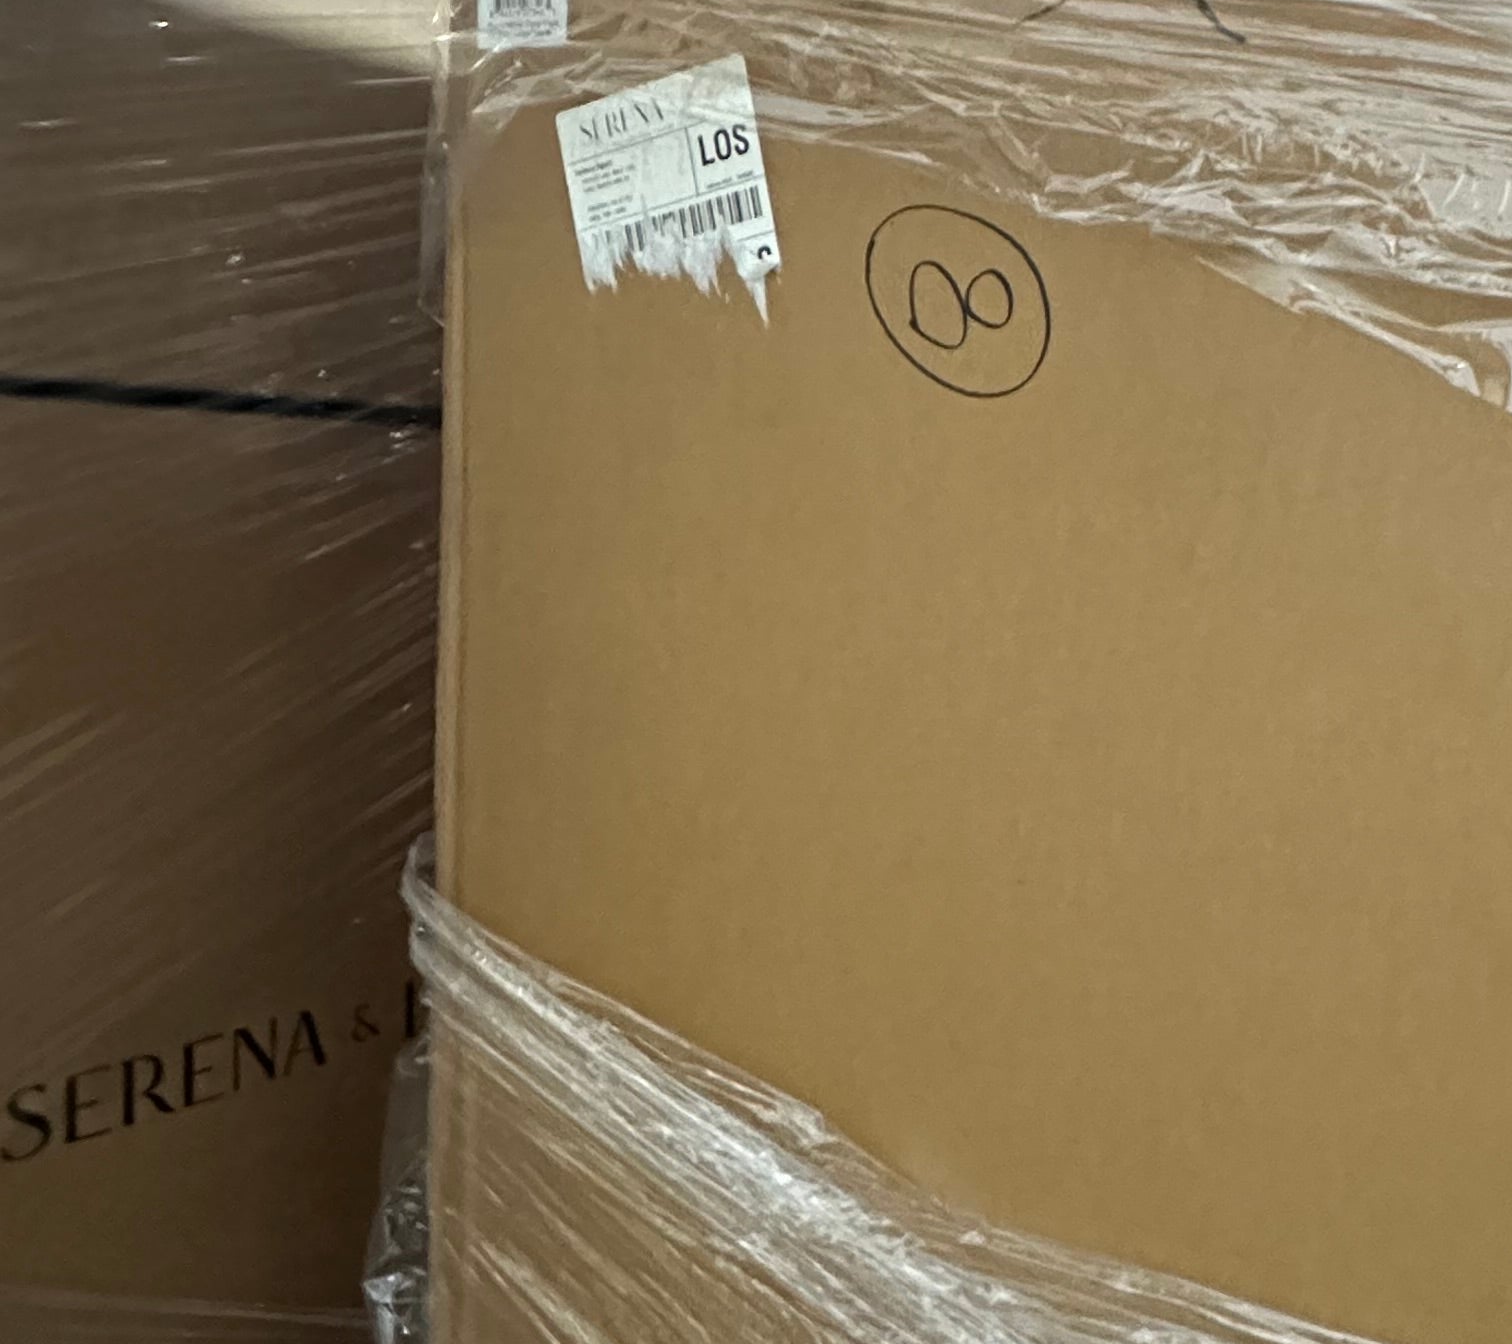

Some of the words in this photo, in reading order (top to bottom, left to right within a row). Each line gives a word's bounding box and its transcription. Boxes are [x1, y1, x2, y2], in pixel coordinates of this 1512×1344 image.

[697, 124, 749, 167] LOS
[1, 1009, 327, 1163] SERENA
[351, 1003, 380, 1043] &
